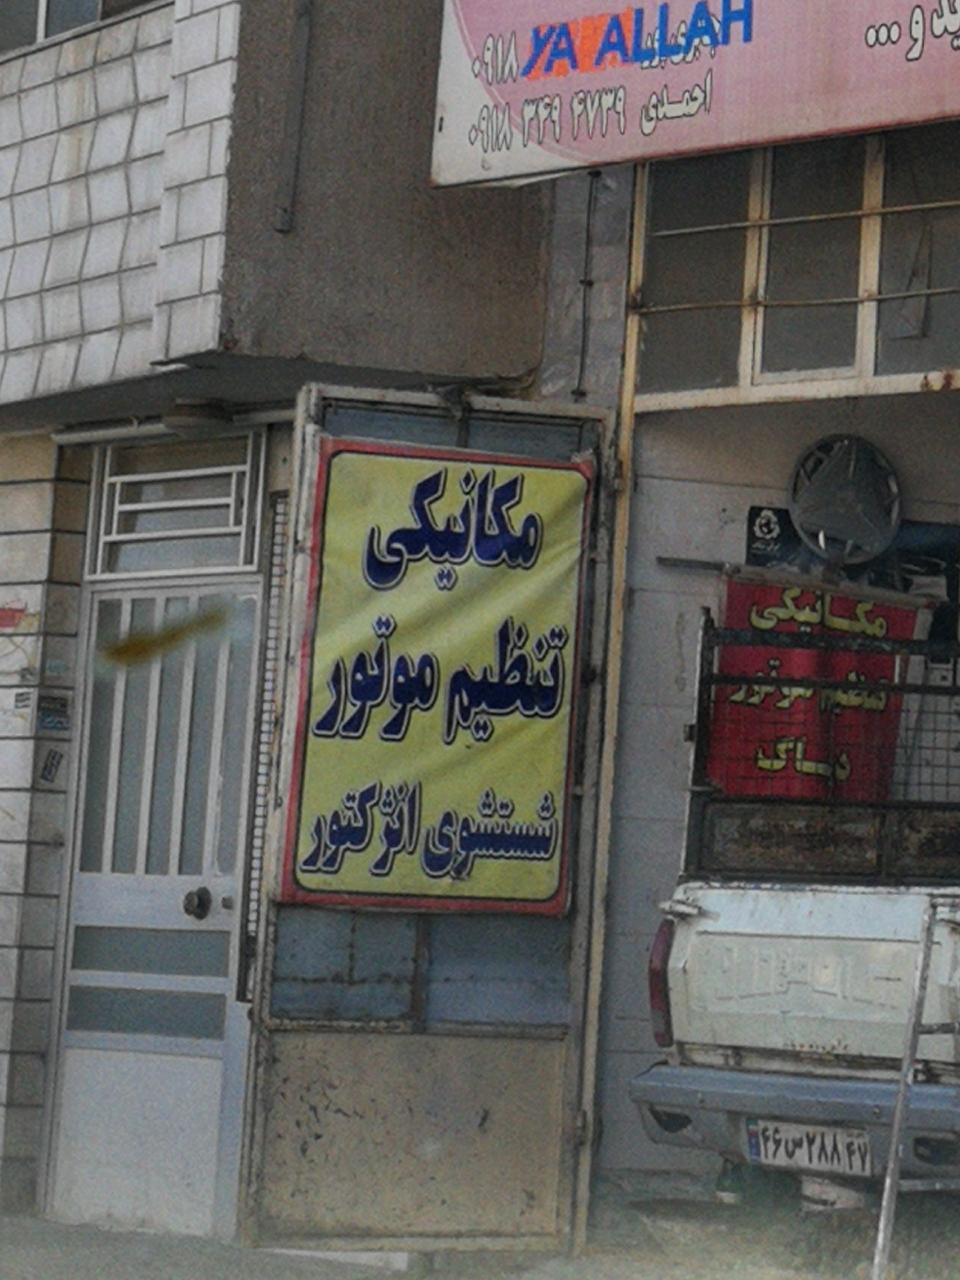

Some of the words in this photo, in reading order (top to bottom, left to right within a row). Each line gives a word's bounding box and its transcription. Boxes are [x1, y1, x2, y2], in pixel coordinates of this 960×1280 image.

[905, 4, 926, 62] و
[640, 67, 714, 137] احمدی
[363, 467, 543, 590] مکانیکی
[750, 586, 888, 638] مکانیکی
[313, 613, 440, 739] موتور
[443, 615, 570, 745] تنظیم
[300, 778, 422, 877] انژکتور
[422, 786, 560, 883] شستشوی
